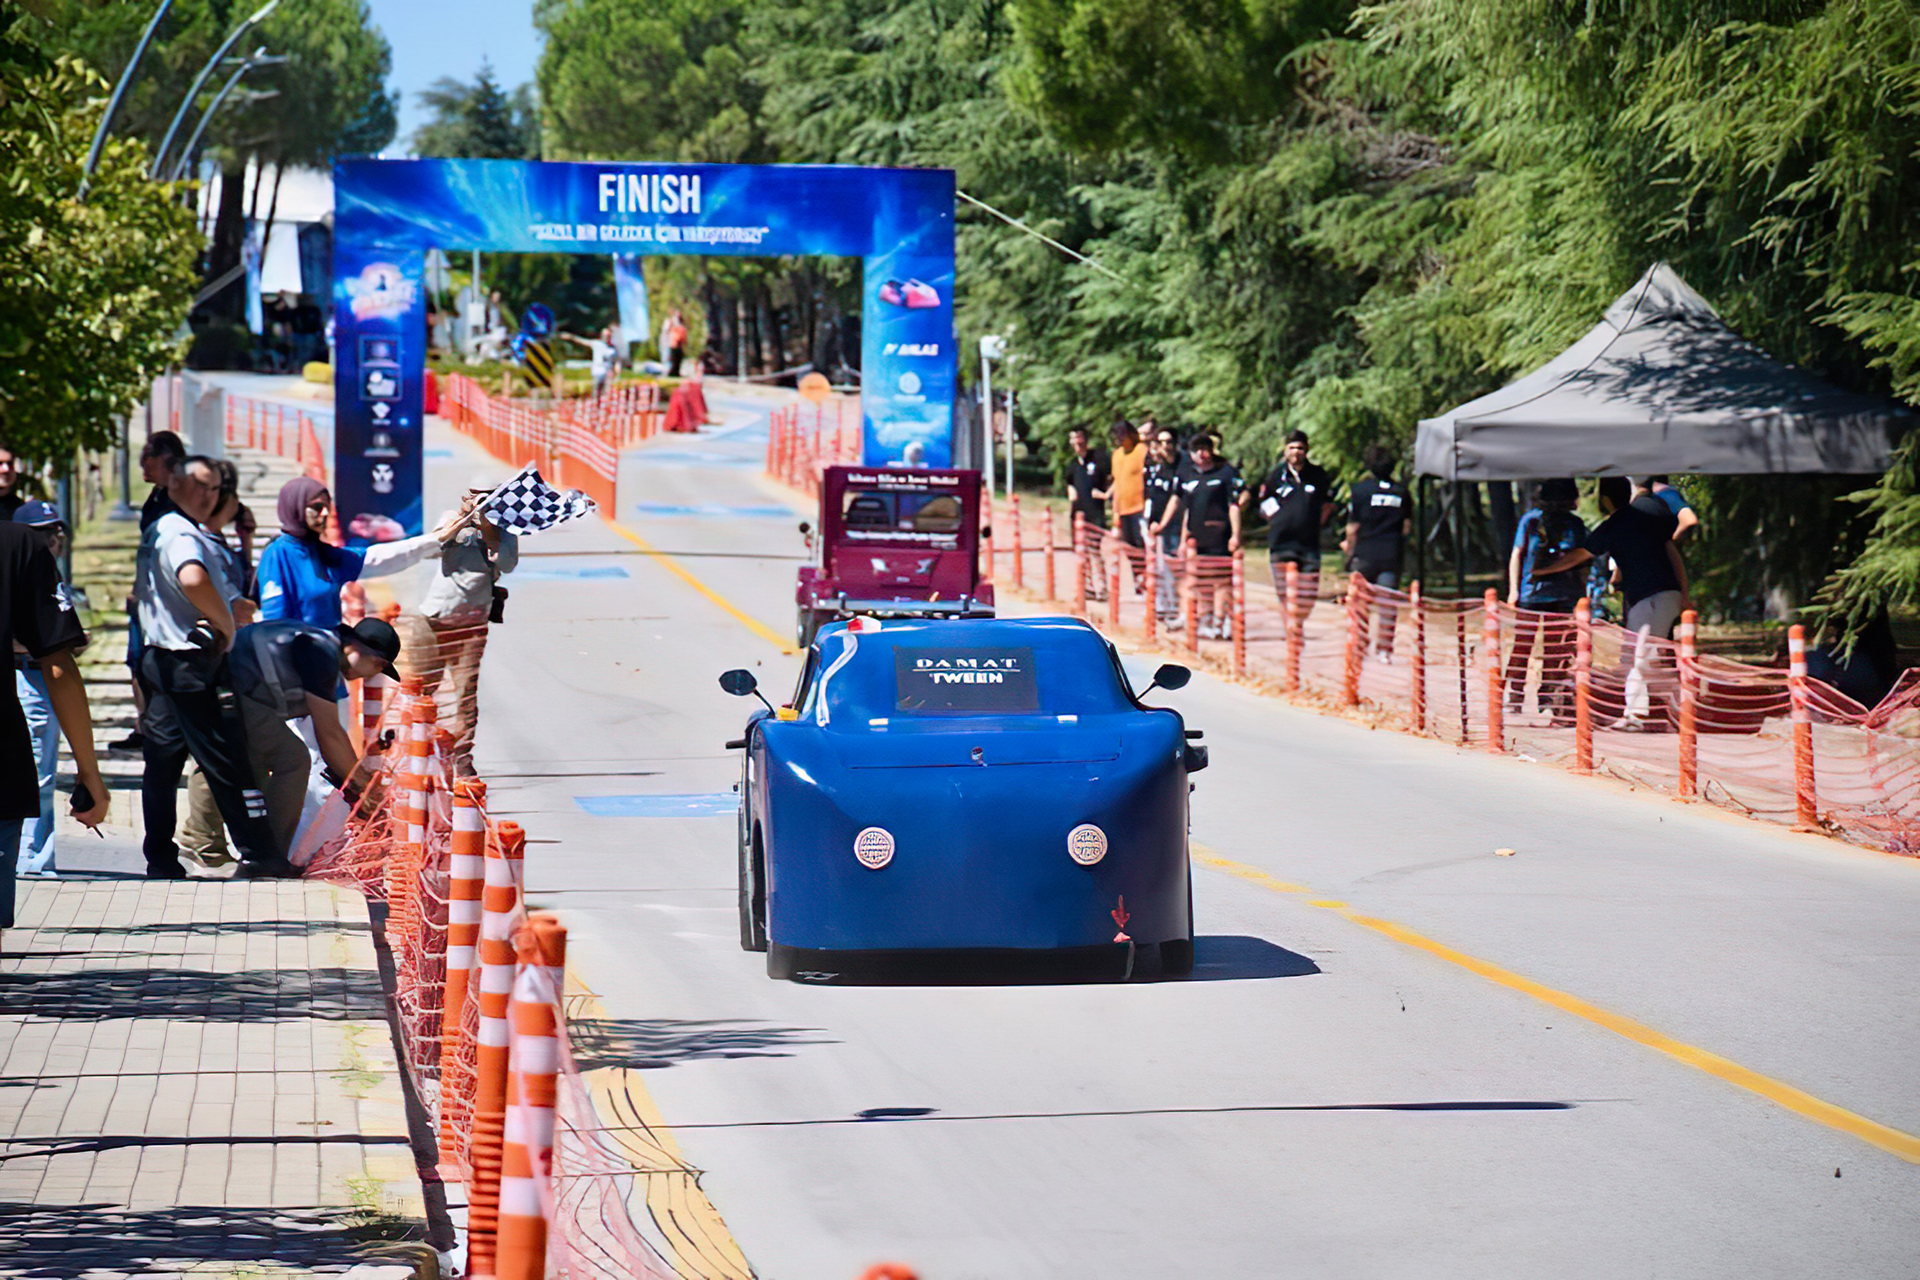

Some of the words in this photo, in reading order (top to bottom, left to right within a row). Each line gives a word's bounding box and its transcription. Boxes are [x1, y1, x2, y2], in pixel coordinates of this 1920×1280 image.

[599, 174, 701, 214] FINISH
[916, 658, 1018, 669] DAMAT
[929, 672, 1004, 684] TWEEN
